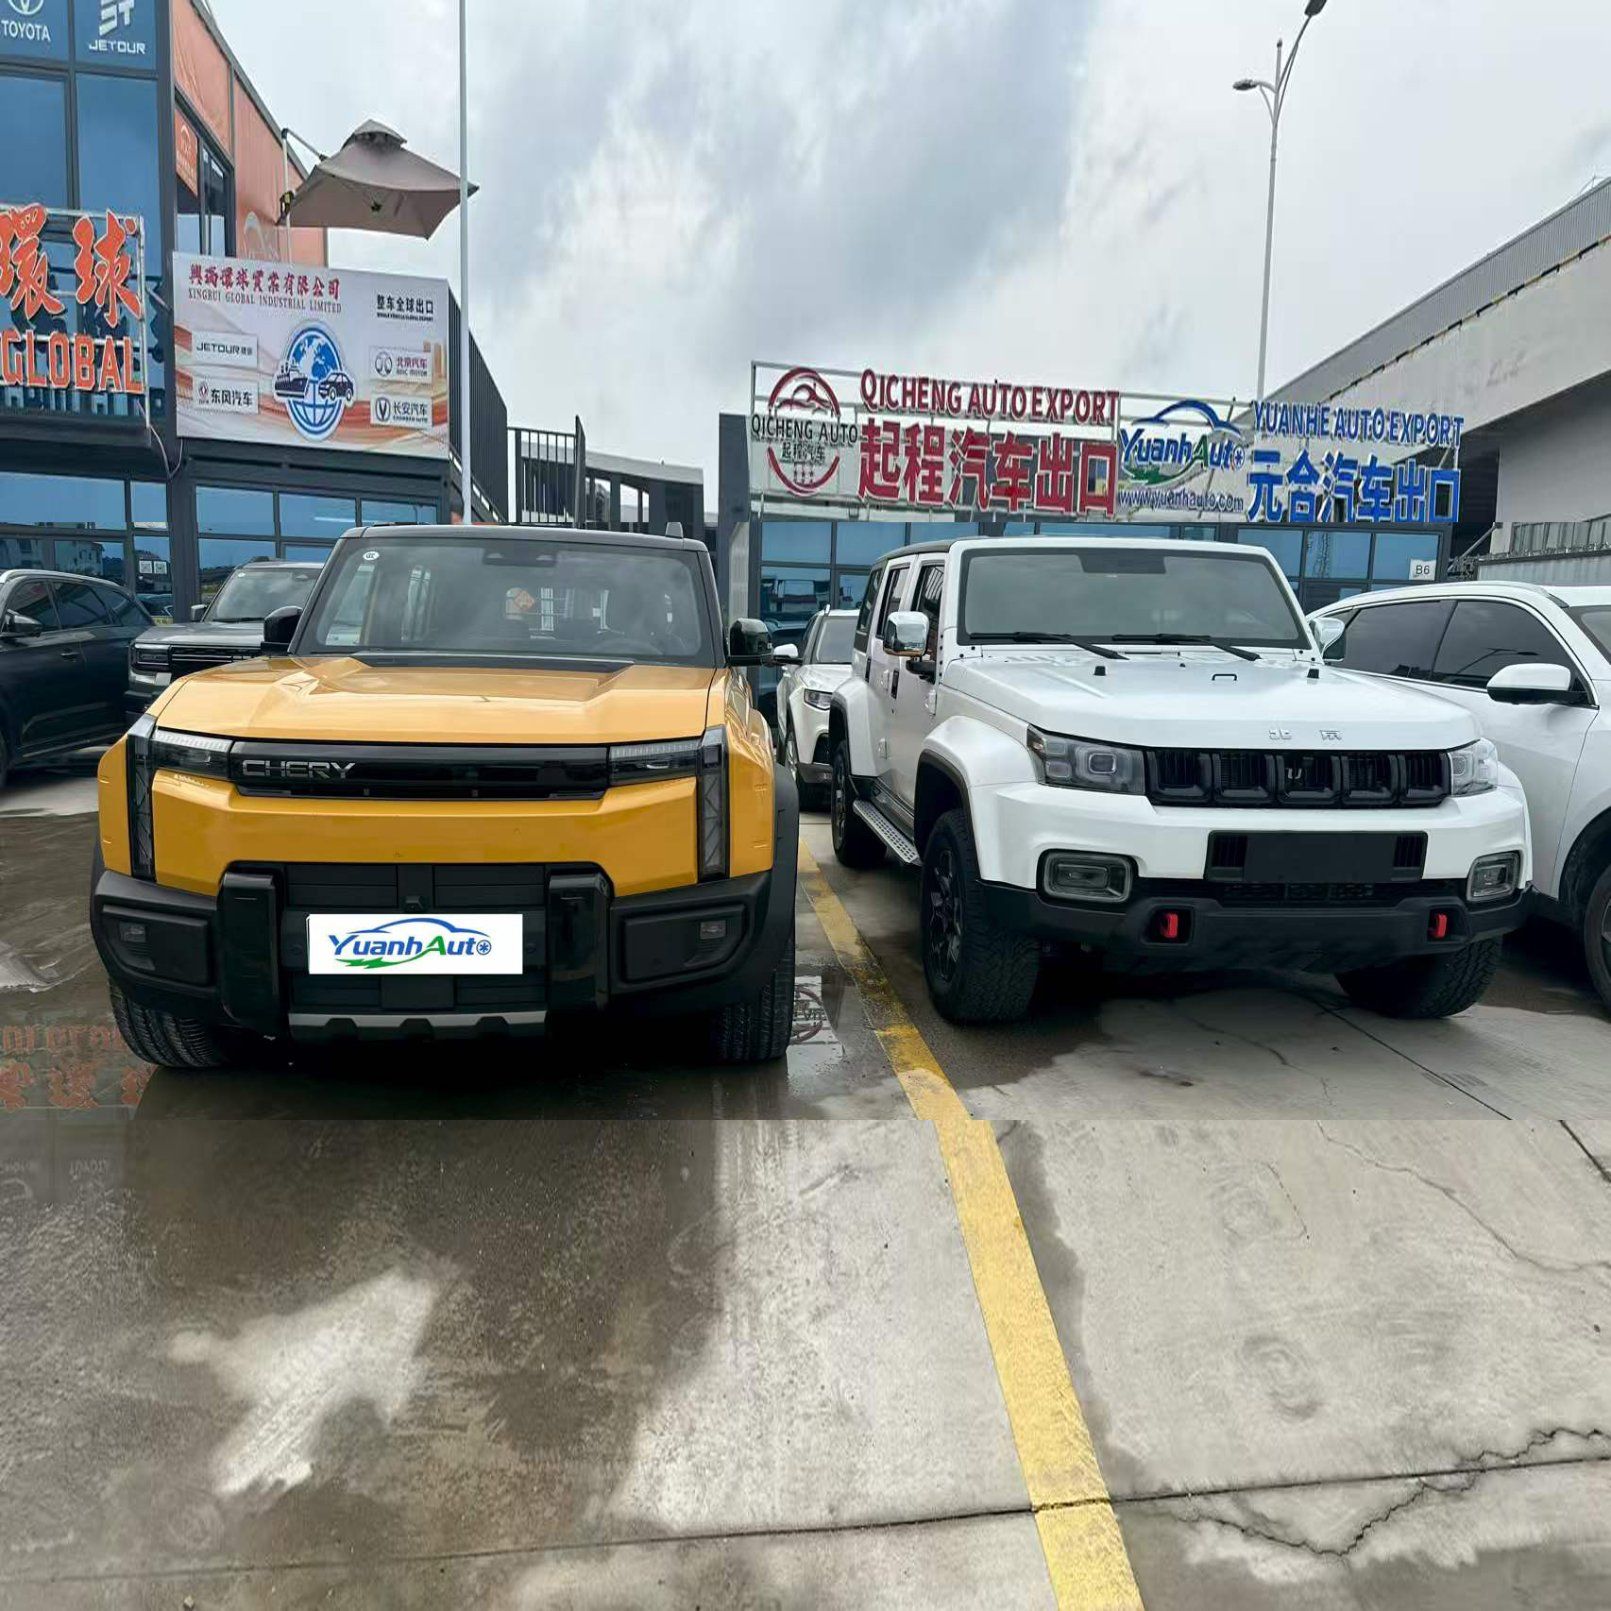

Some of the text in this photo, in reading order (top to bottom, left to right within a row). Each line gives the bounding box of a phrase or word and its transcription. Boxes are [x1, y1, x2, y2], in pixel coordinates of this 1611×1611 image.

[1, 20, 51, 42] TOYOTA
[88, 40, 146, 55] JETOUR
[225, 292, 255, 305] GLOBAL
[259, 295, 305, 310] INDUSTRIAL
[309, 300, 342, 314] LIMITED
[377, 294, 434, 314] 整车全球出口
[196, 342, 240, 355] JETOUR
[0, 329, 145, 394] GLOBAL
[211, 388, 253, 406] 东风汽车
[860, 368, 1120, 424] QICHENG AUTO EXPORT
[393, 401, 428, 415] 长安汽车
[752, 414, 858, 443] QICHENG AUTO
[1251, 400, 1465, 450] YUANHE AUTO EXPORT
[857, 417, 1118, 518] 起程汽车出口
[1247, 448, 1462, 522] 元合汽车出口
[1415, 564, 1430, 576] B6
[242, 760, 356, 779] CHERY
